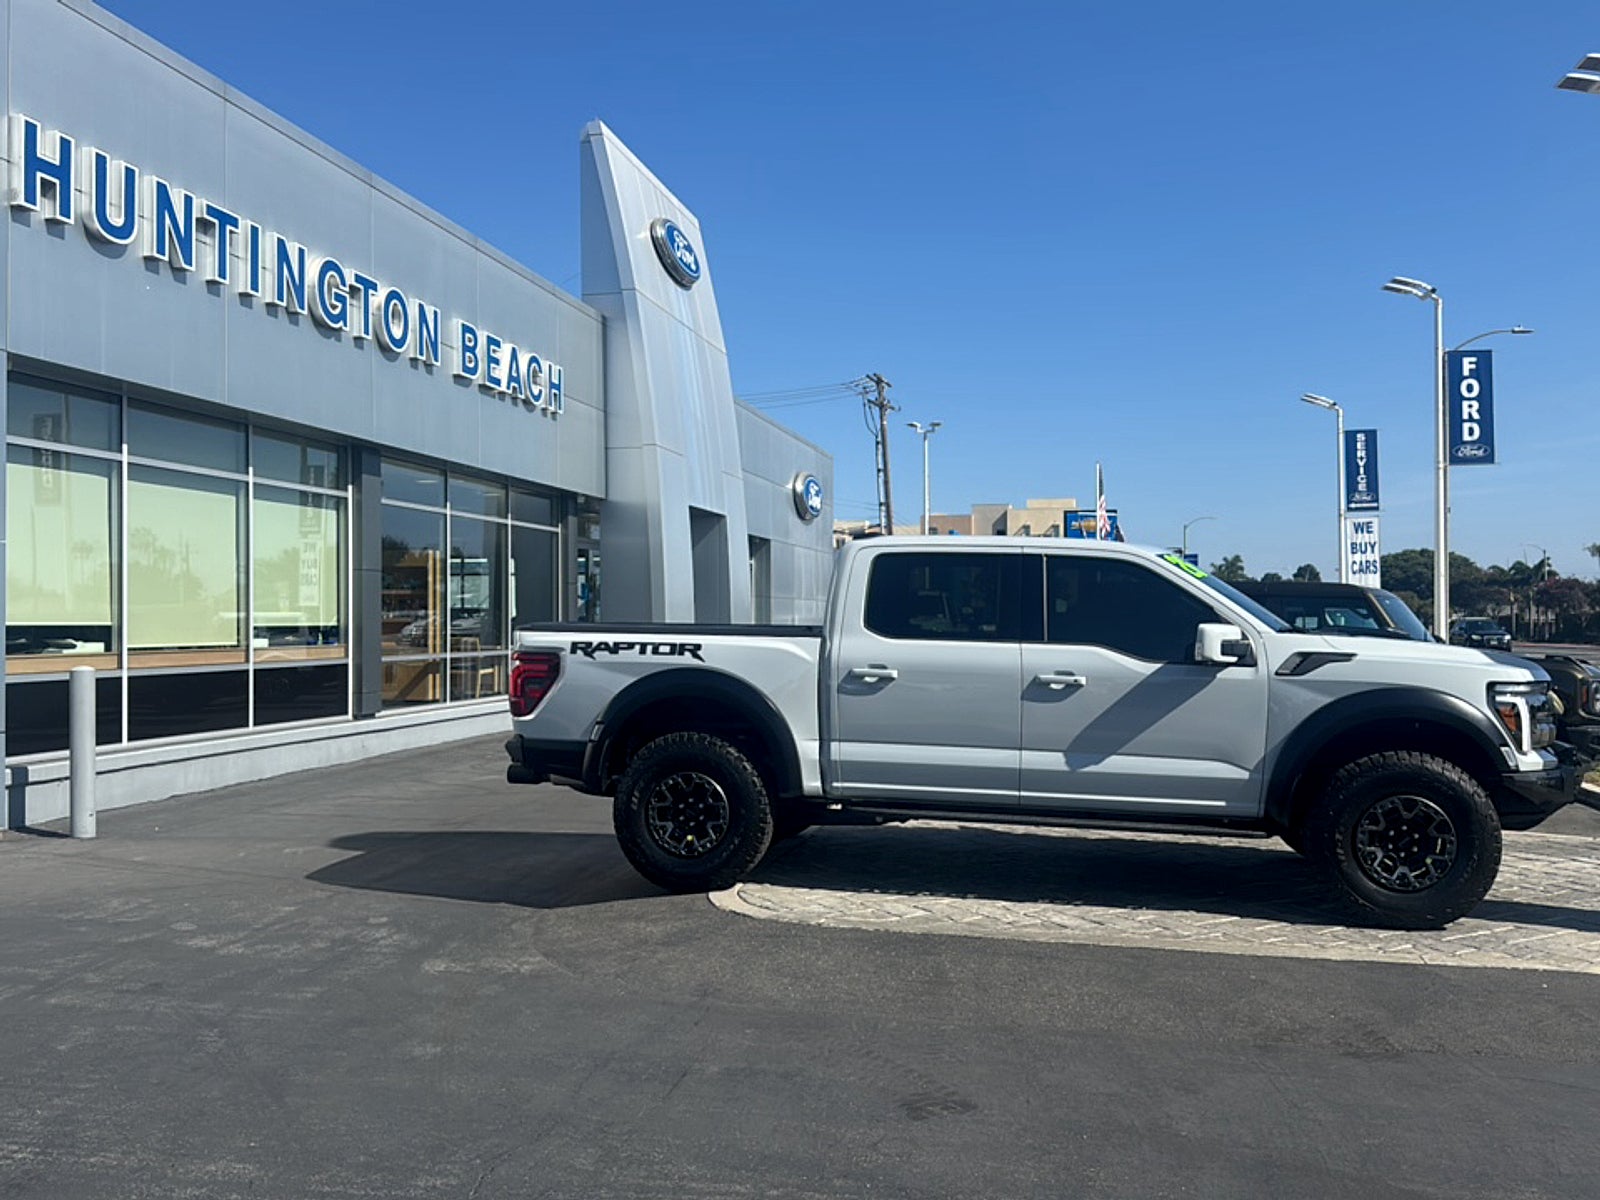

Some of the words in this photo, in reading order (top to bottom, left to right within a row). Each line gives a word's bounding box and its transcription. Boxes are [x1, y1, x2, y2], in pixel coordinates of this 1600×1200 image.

[673, 230, 697, 271] Ford
[9, 113, 442, 367] HUNTINGTON
[453, 317, 564, 415] BEACH
[1460, 356, 1481, 442] FORD
[1356, 432, 1368, 492] SERVICE
[1457, 444, 1485, 458] Ford
[1353, 521, 1374, 535] WE
[1350, 541, 1377, 555] BUY
[1351, 560, 1378, 575] CARS
[570, 641, 706, 663] RAPTOR
